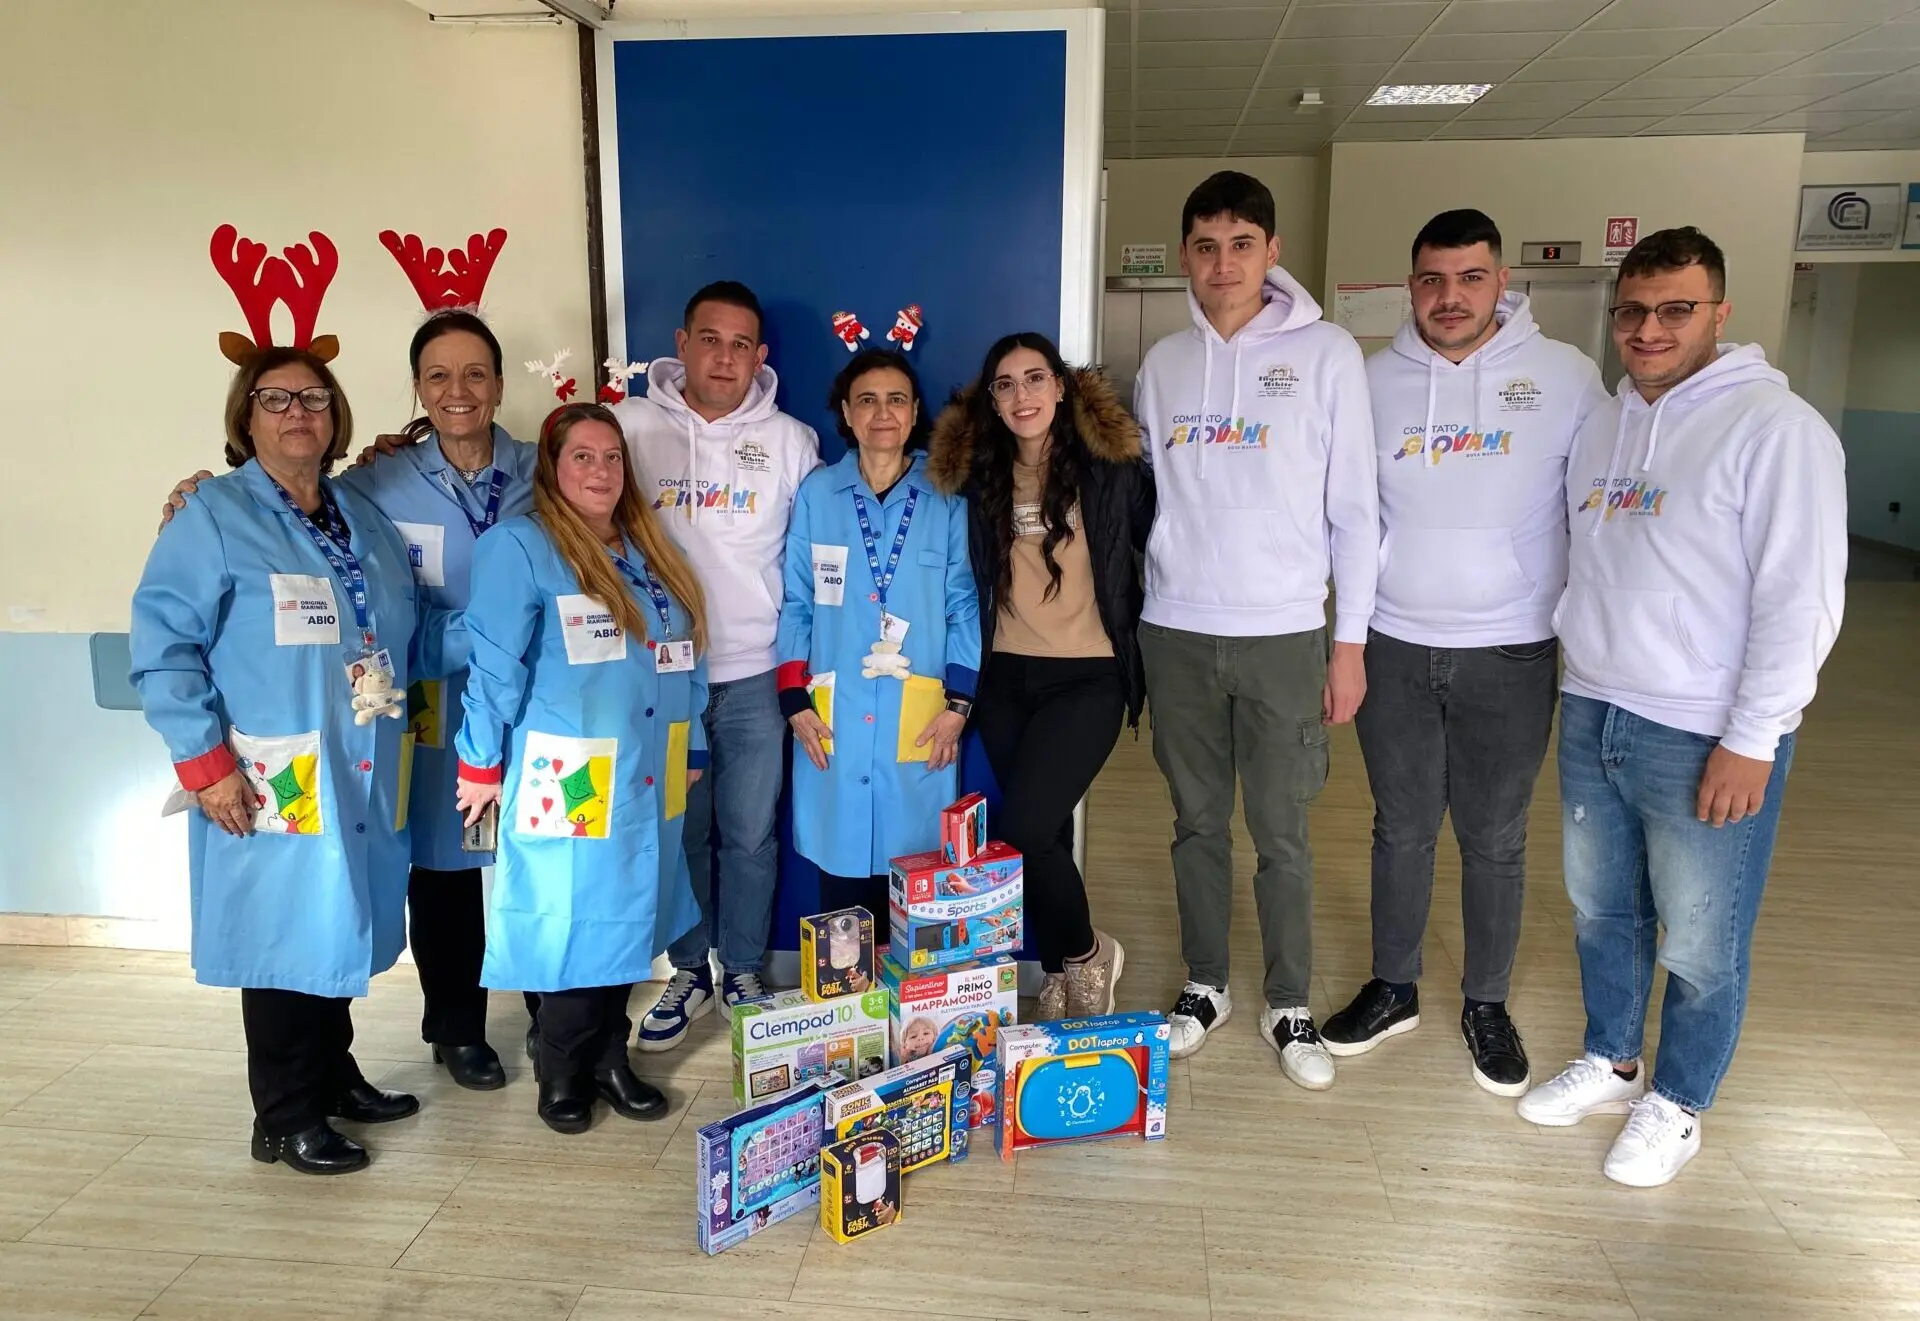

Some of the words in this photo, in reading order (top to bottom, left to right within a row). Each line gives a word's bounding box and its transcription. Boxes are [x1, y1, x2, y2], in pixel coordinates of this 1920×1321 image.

[1548, 248, 1555, 258] 5
[1403, 424, 1459, 435] COMTATO
[307, 615, 336, 625] ABIO
[947, 902, 988, 917] Sports
[821, 981, 841, 991] FAST
[821, 987, 842, 996] PUSH
[905, 980, 945, 993] Sapientino
[957, 980, 992, 994] PRIMO
[911, 991, 992, 1013] MAPPAMONDO
[750, 1009, 834, 1040] Clempad
[836, 1004, 853, 1024] 10
[1061, 1021, 1089, 1030] DOT
[1068, 1036, 1098, 1051] DOT
[1098, 1037, 1129, 1048] laptop
[840, 1095, 872, 1113] SONIC
[847, 1215, 868, 1229] FAST
[847, 1222, 869, 1235] PUSH
